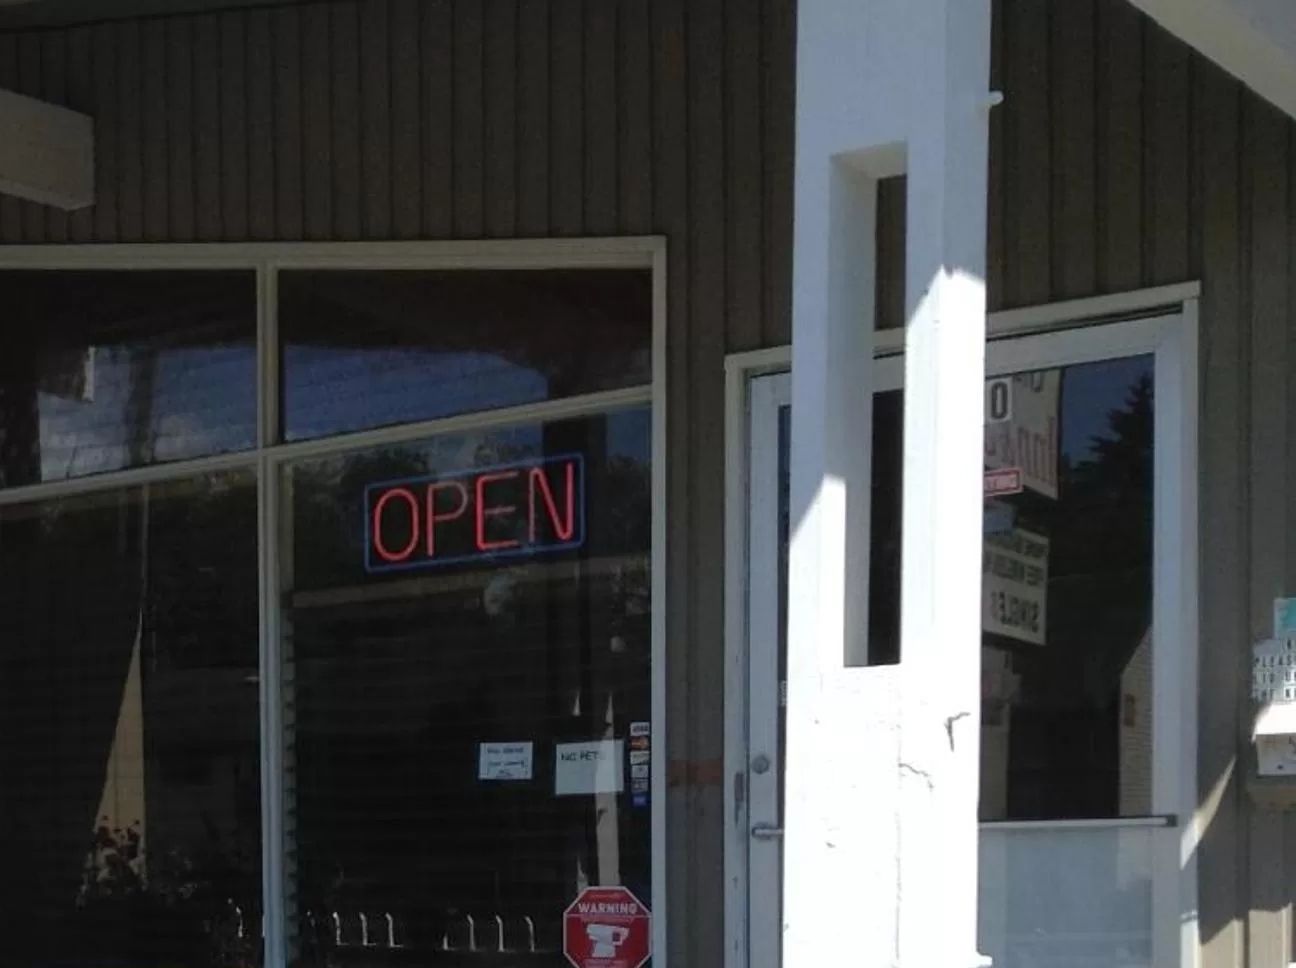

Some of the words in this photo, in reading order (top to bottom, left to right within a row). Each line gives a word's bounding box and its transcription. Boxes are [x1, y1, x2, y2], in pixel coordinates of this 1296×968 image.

[372, 461, 575, 562] OPEN
[580, 749, 606, 761] PET
[578, 901, 638, 915] WARNING
